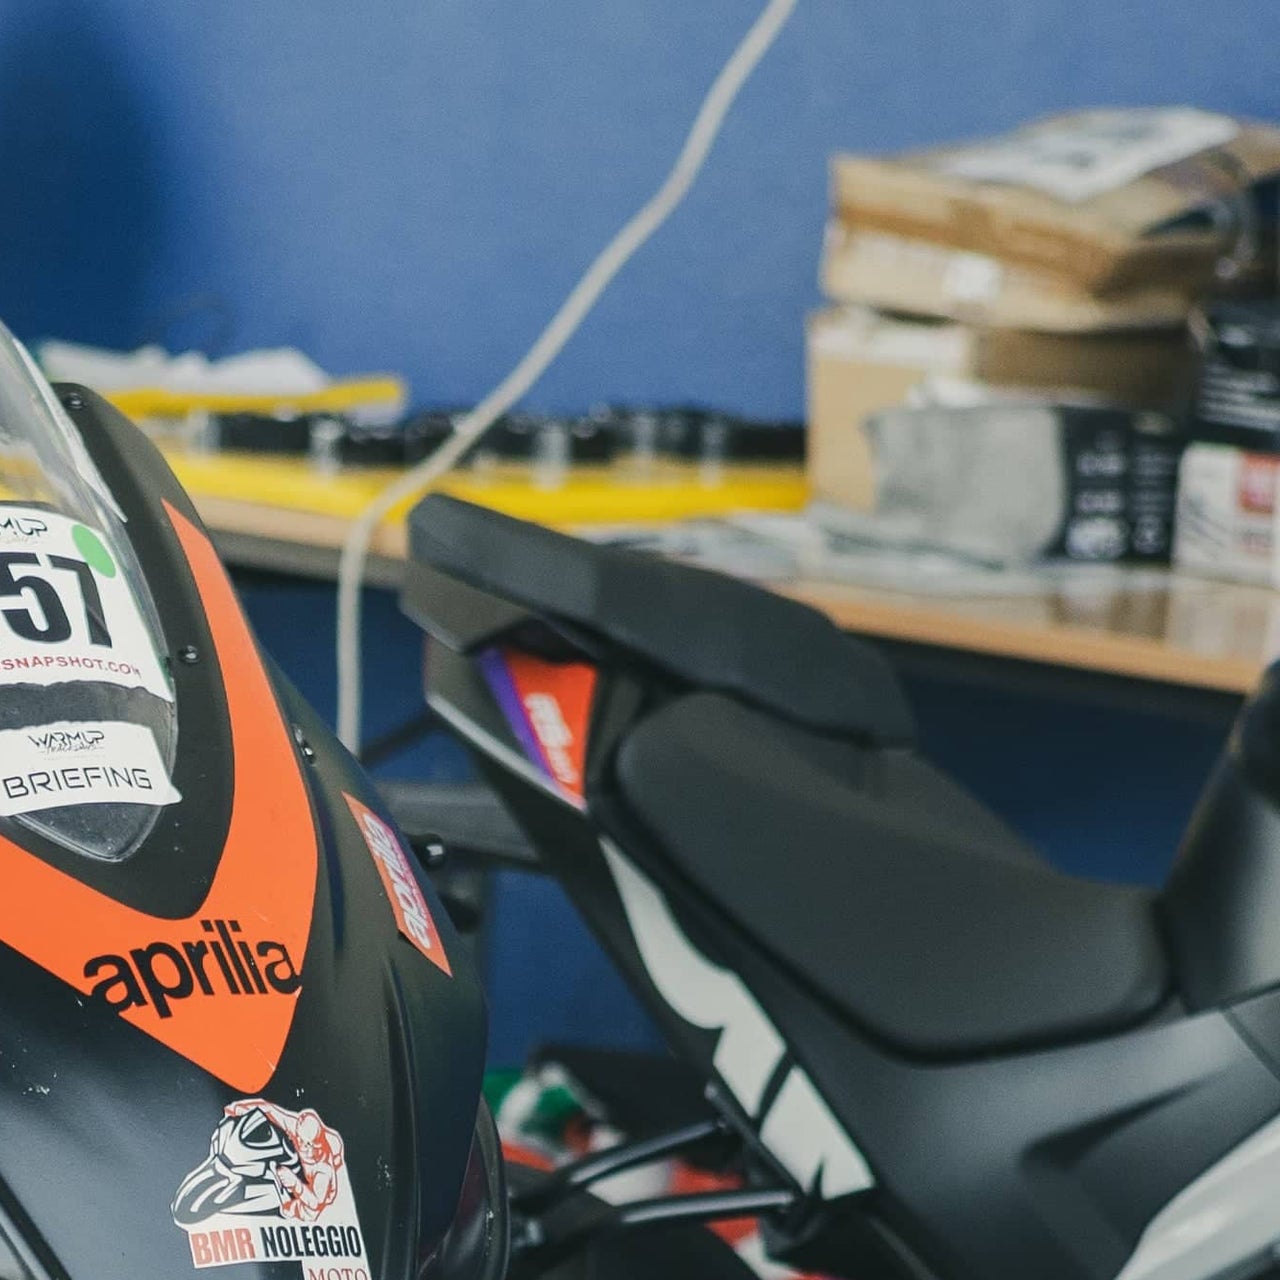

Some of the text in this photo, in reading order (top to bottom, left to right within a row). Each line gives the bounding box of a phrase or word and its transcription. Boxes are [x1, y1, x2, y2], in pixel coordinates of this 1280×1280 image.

[2, 767, 153, 799] BRIEFING
[82, 919, 304, 1019] aprilia
[191, 1225, 362, 1265] BMR NOLEGGIO
